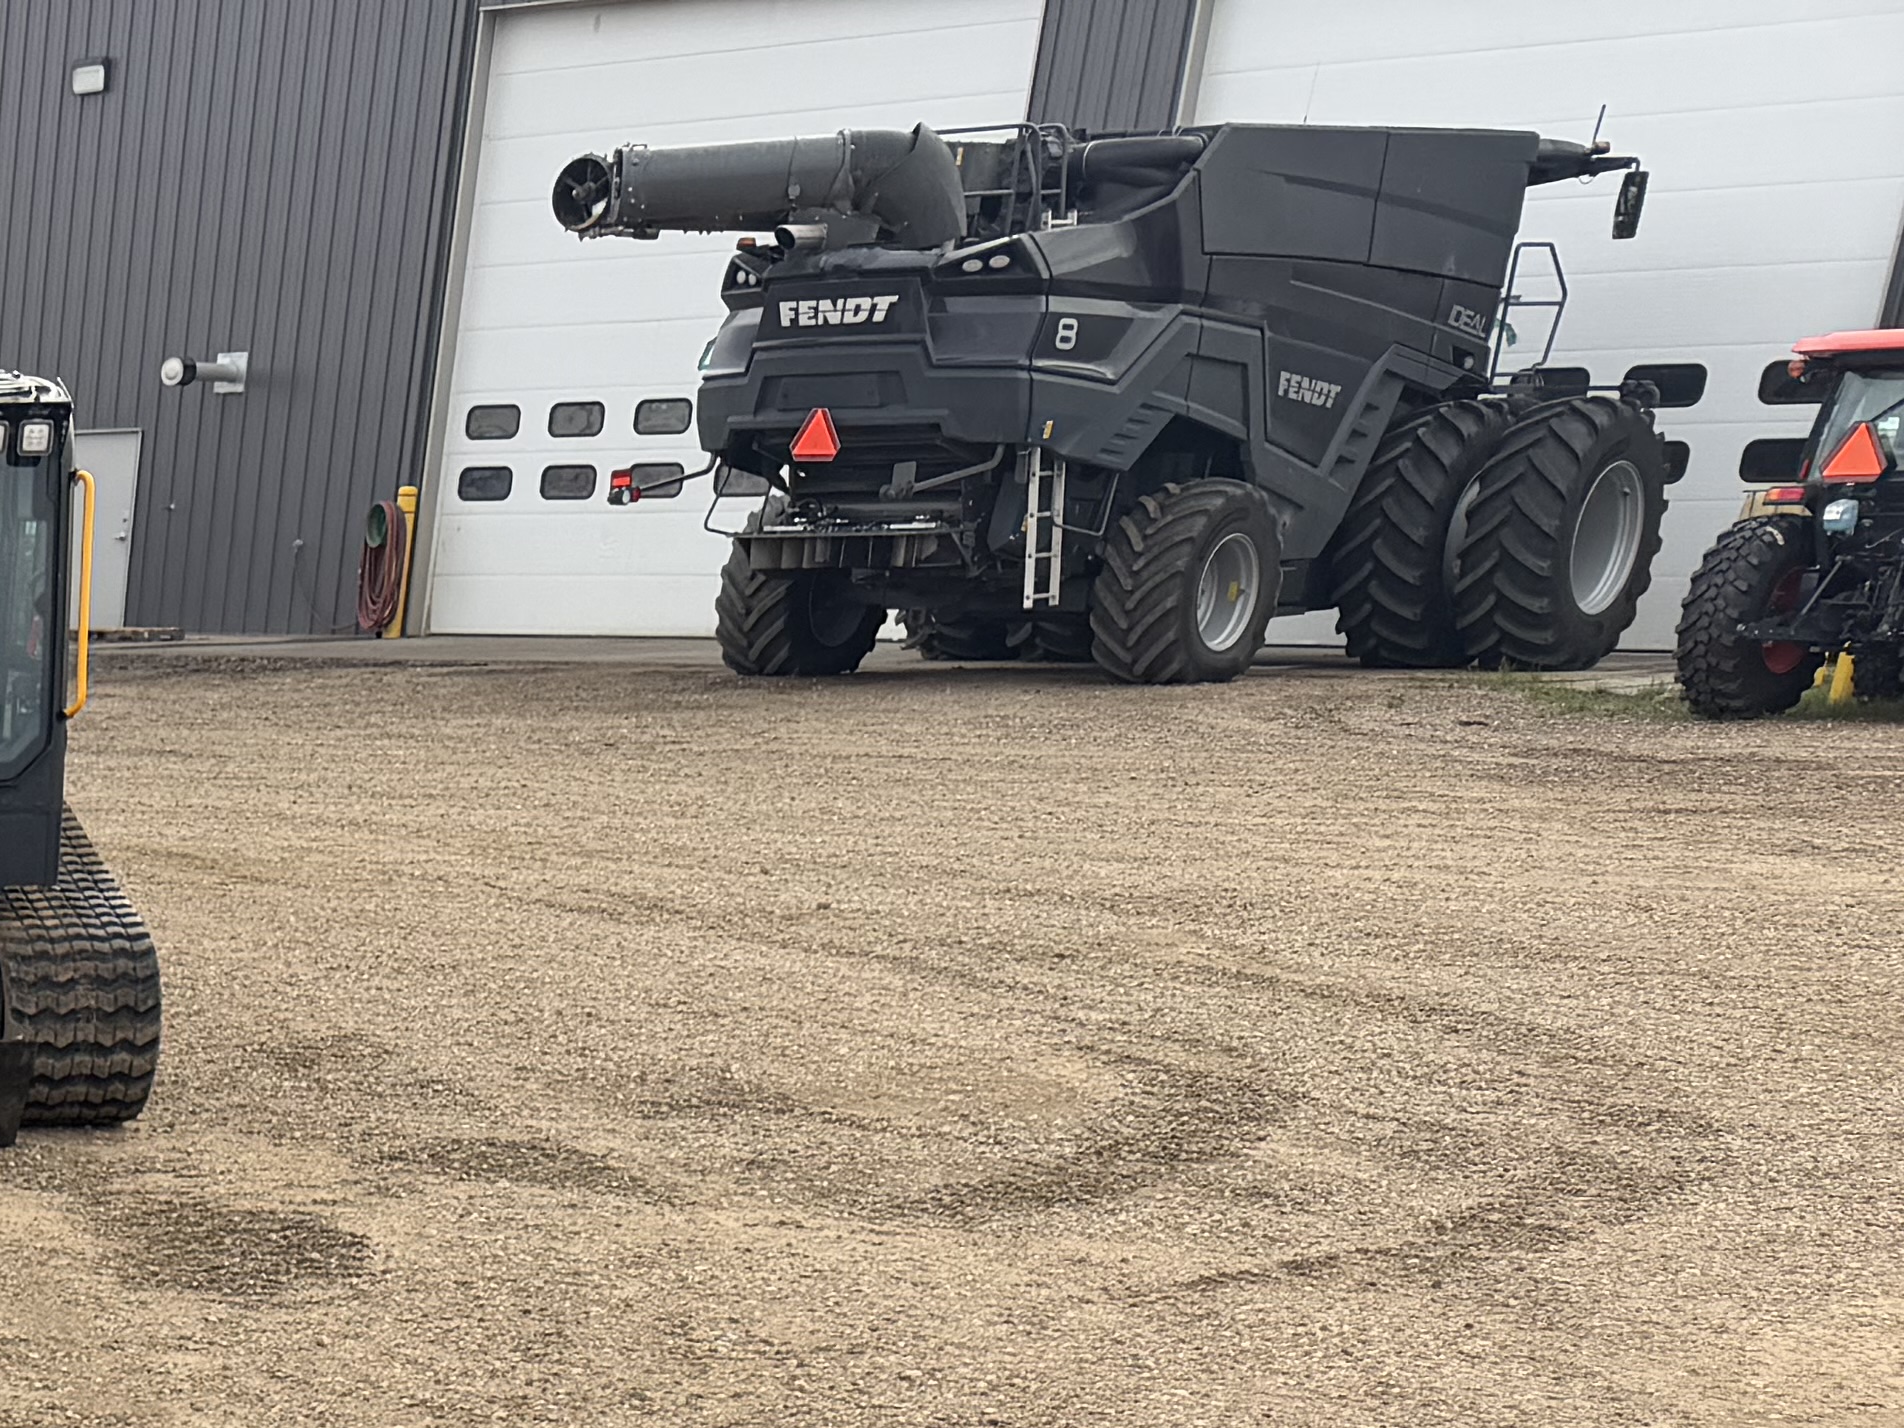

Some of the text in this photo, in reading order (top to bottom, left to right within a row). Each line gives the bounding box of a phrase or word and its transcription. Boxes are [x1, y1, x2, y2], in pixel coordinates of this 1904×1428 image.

[779, 295, 899, 327] FENDT
[1055, 318, 1079, 350] 8
[1277, 370, 1342, 409] FENDT
